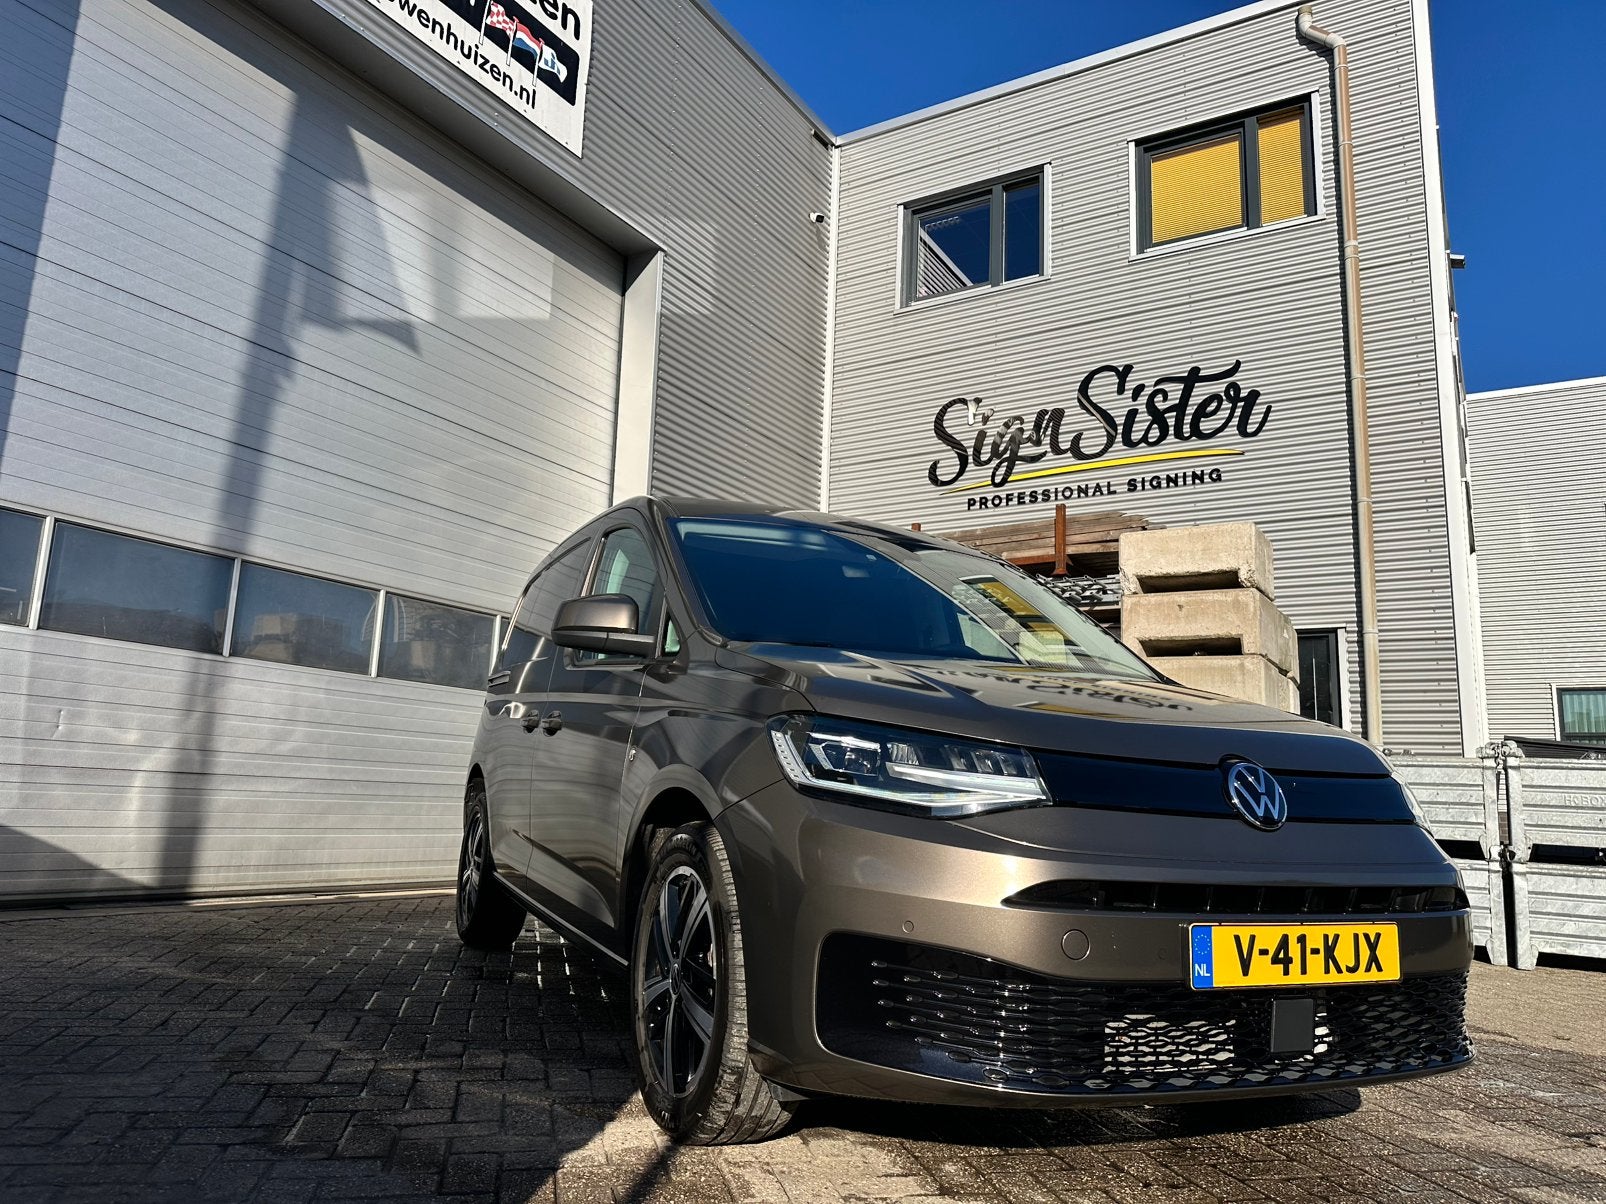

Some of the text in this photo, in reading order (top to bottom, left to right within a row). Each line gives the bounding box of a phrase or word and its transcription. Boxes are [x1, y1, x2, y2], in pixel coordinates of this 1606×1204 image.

[376, 0, 537, 109] wenhuizen.nl
[967, 468, 1223, 511] PROFESSIONAL SIGNING
[1194, 963, 1211, 977] NL
[1233, 932, 1384, 977] V-41-KJX
